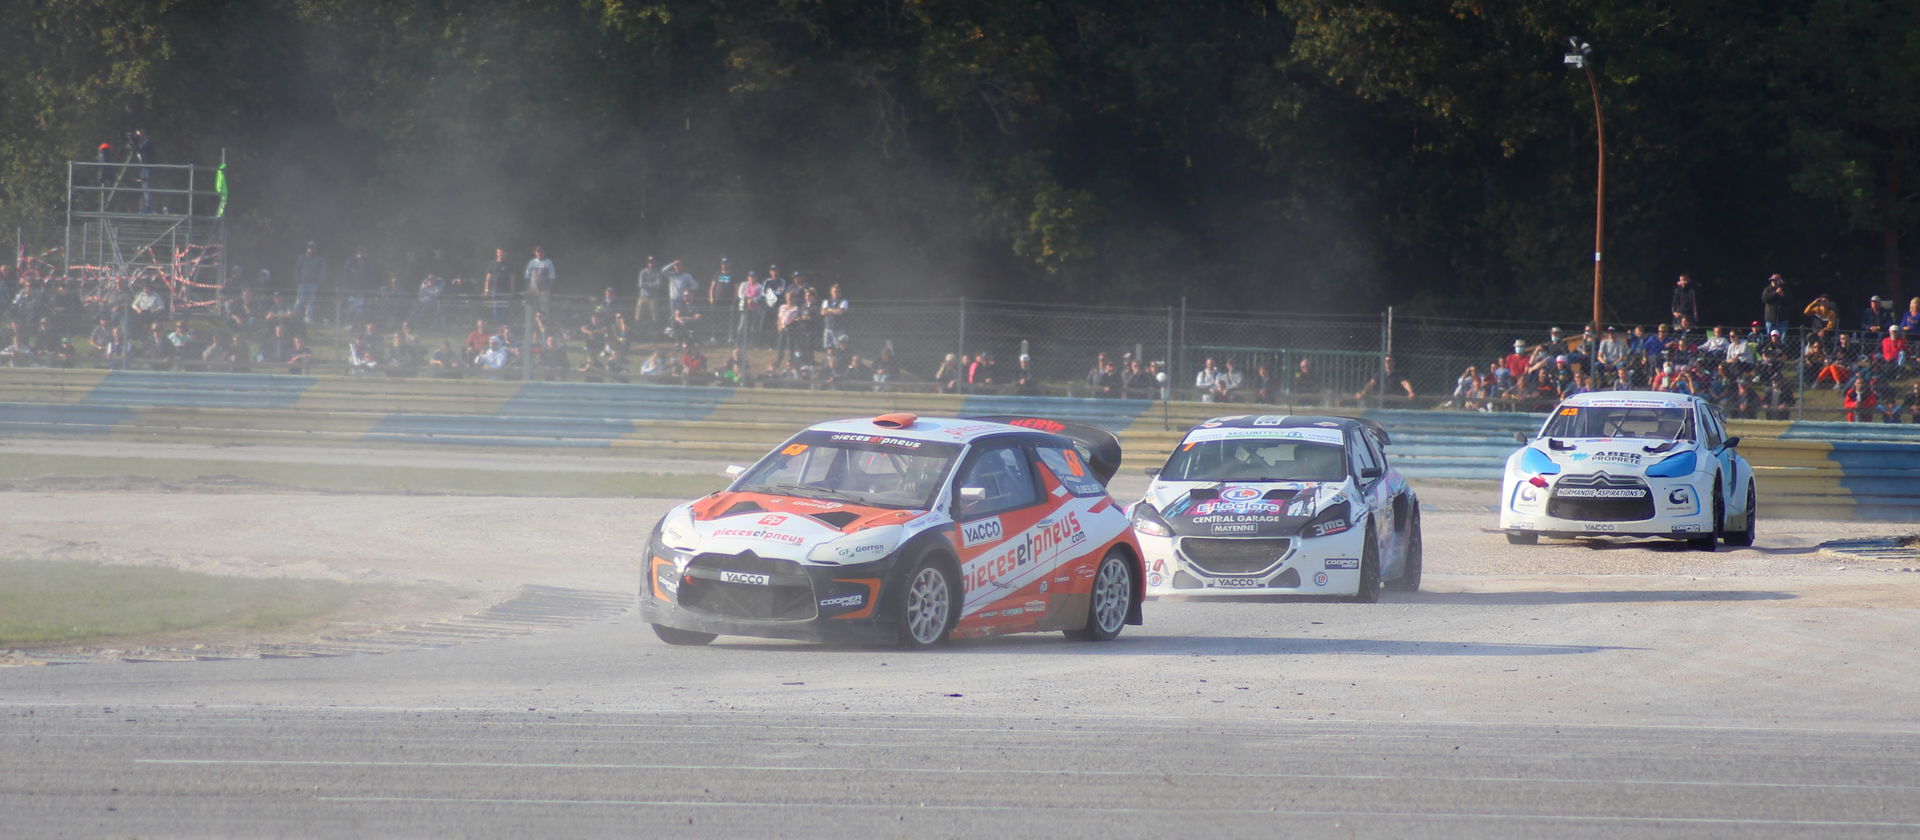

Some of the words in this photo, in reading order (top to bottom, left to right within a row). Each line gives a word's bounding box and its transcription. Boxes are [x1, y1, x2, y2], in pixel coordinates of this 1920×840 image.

[1595, 451, 1642, 459] ABER
[1193, 515, 1235, 523] CENTRAL
[712, 528, 805, 545] piecesetpneus
[964, 521, 1000, 543] YACCO
[964, 511, 1082, 592] piecesetpneus
[726, 572, 764, 584] YACCO
[1218, 578, 1254, 587] YACCO
[820, 595, 862, 606] COOPER
